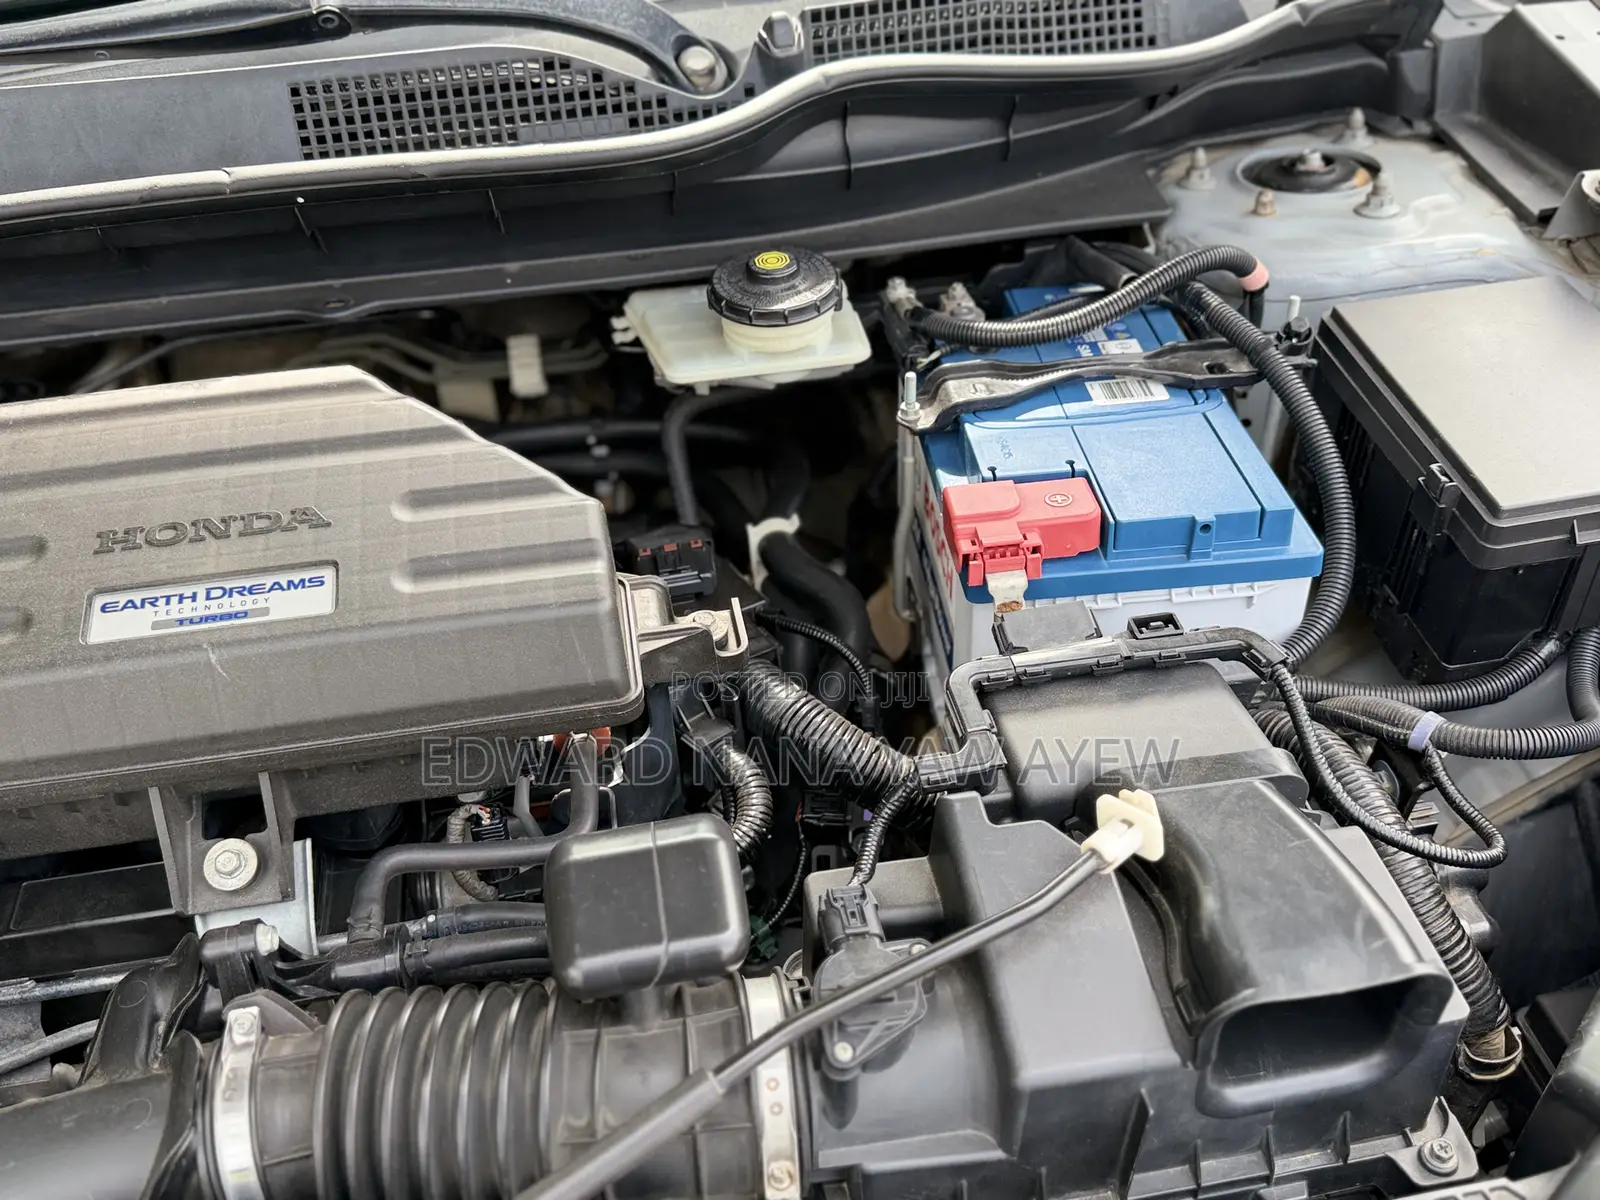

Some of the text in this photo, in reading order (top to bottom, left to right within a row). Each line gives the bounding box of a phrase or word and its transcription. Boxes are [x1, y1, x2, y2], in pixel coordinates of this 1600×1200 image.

[92, 505, 333, 555] HONDA
[100, 575, 326, 614] EARTH DREAMS
[153, 597, 270, 617] TECHNOLOGY
[175, 611, 249, 626] TURBO
